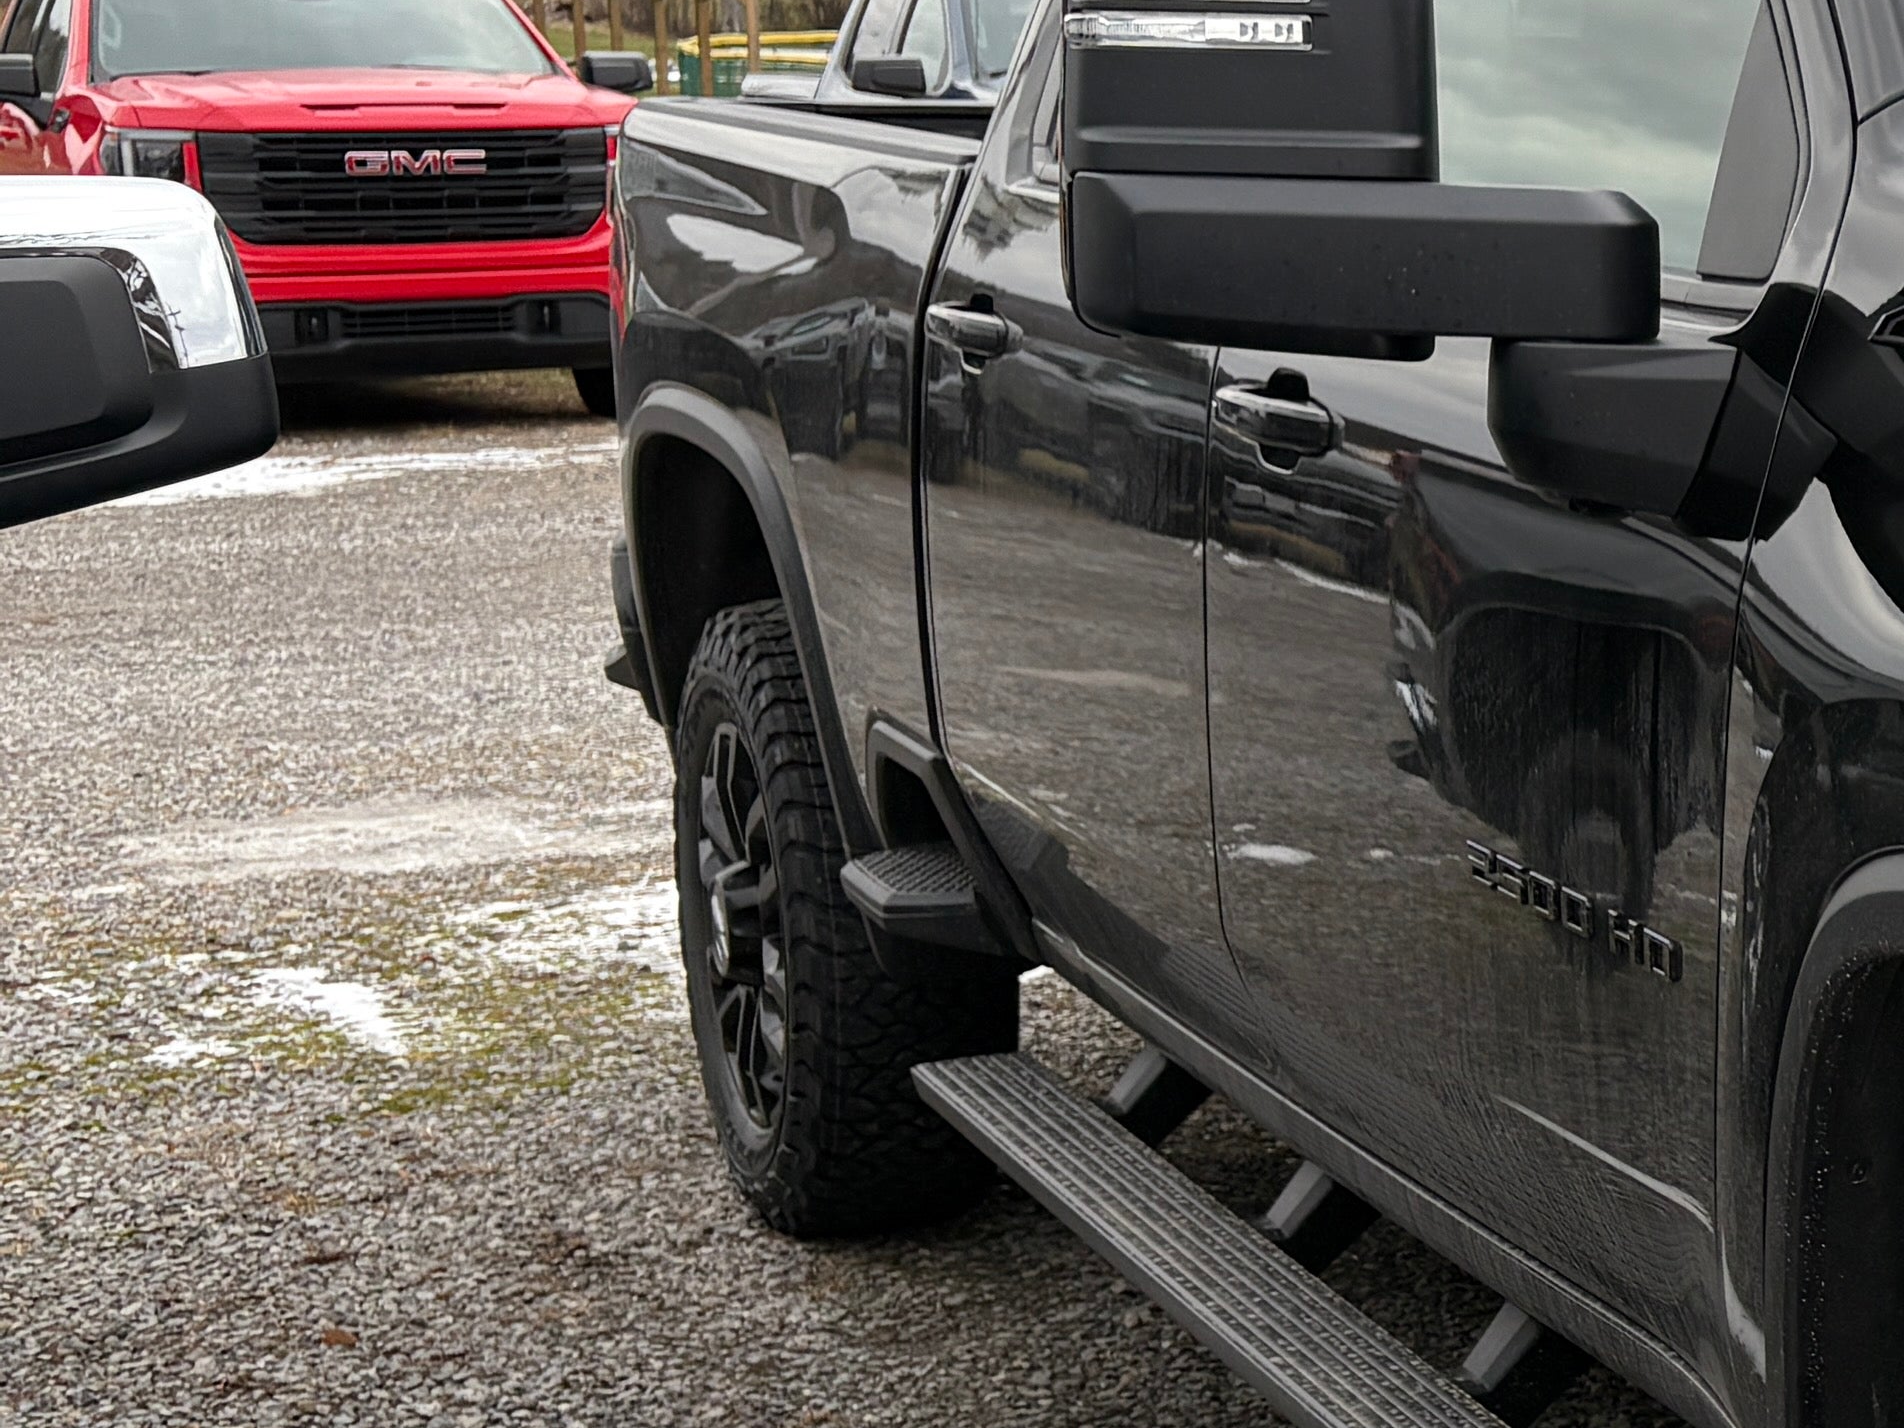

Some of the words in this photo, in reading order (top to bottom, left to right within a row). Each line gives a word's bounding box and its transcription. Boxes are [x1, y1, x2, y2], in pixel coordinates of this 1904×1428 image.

[344, 148, 488, 177] GMC
[1466, 839, 1594, 940] 2500
[1608, 909, 1684, 983] HD
